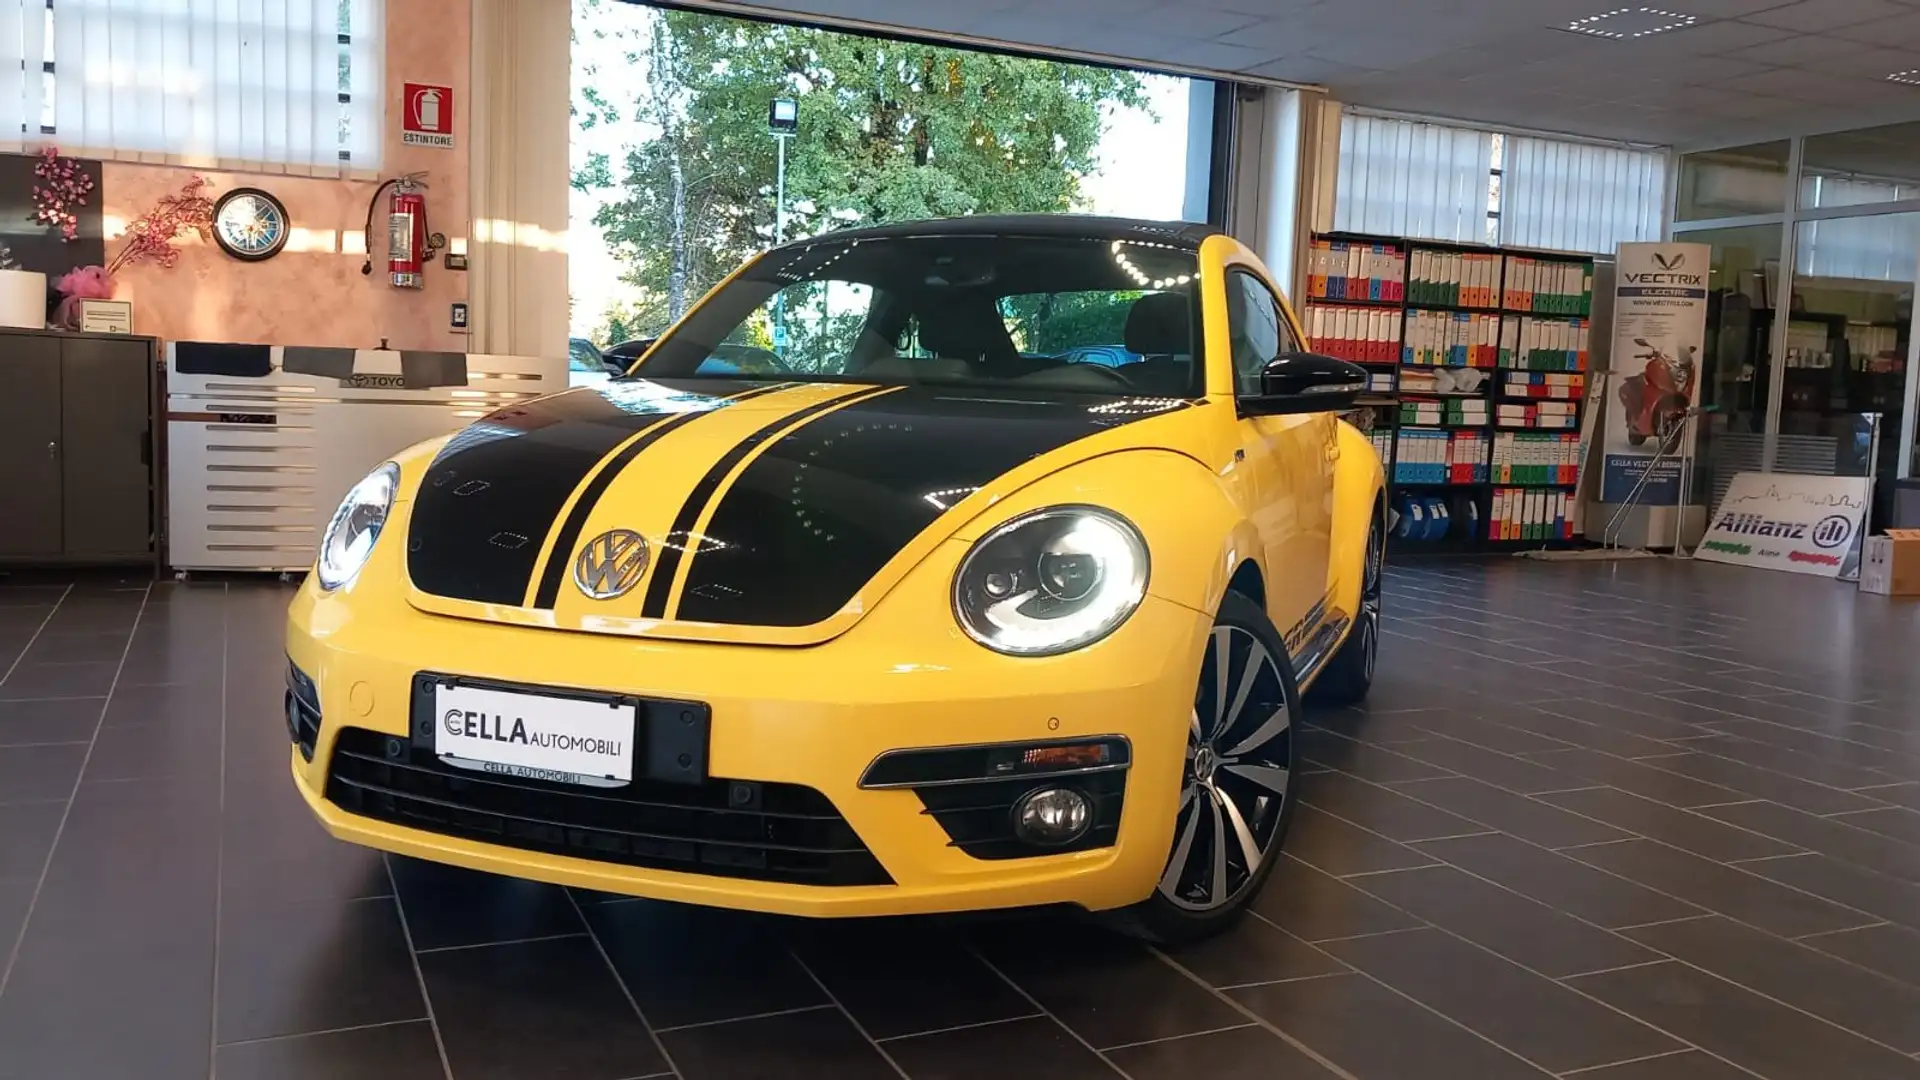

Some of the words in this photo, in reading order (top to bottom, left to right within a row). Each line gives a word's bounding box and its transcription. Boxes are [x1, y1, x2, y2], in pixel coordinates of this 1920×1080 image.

[404, 132, 453, 146] ESTINTORE
[1625, 273, 1701, 285] VECTRIX
[1714, 512, 1808, 539] Allianz
[444, 709, 528, 745] CELLA
[530, 732, 622, 756] AUTOMOBILI
[484, 762, 513, 775] CELLA
[516, 766, 581, 784] AUTOMOBILI
